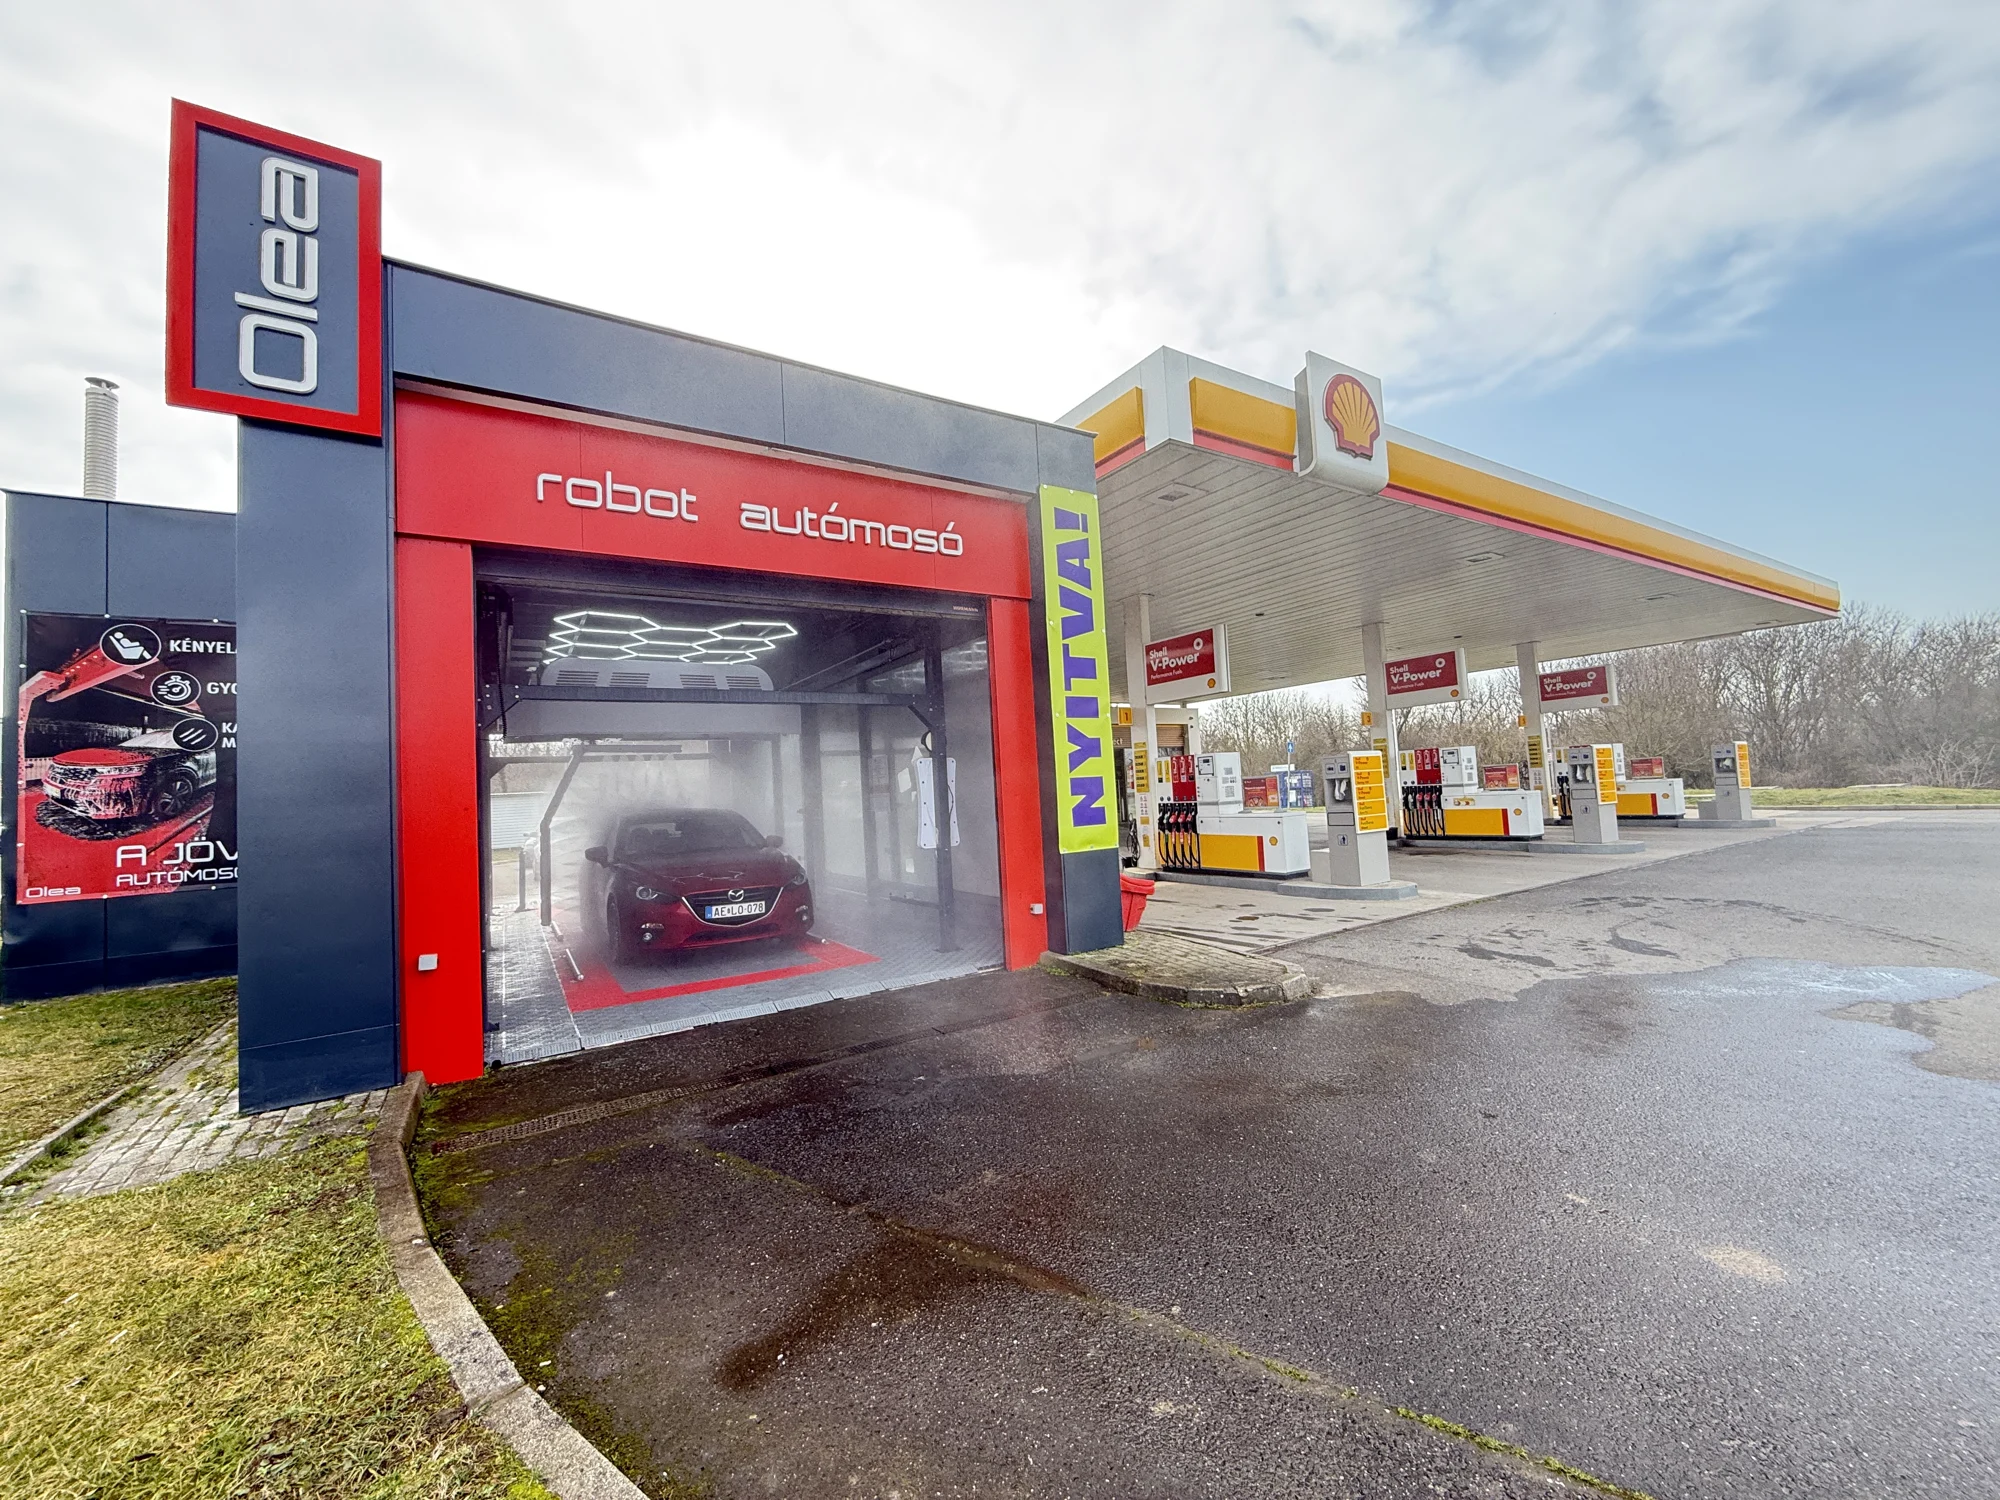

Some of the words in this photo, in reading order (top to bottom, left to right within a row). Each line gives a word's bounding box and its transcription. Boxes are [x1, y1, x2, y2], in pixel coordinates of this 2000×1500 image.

[537, 471, 699, 522] robot
[739, 502, 963, 556] autómosó
[169, 638, 237, 654] KÉNYEL
[1149, 646, 1168, 660] Shell
[1053, 506, 1107, 827] NYITVA!
[1150, 652, 1200, 671] V-Power
[1389, 663, 1409, 674] Shell
[1390, 669, 1442, 684] V-Power
[1544, 680, 1593, 693] V-Power
[116, 844, 147, 867] A
[116, 866, 238, 887] AUTÓMOS
[25, 886, 82, 898] Olea
[714, 906, 727, 917] AE
